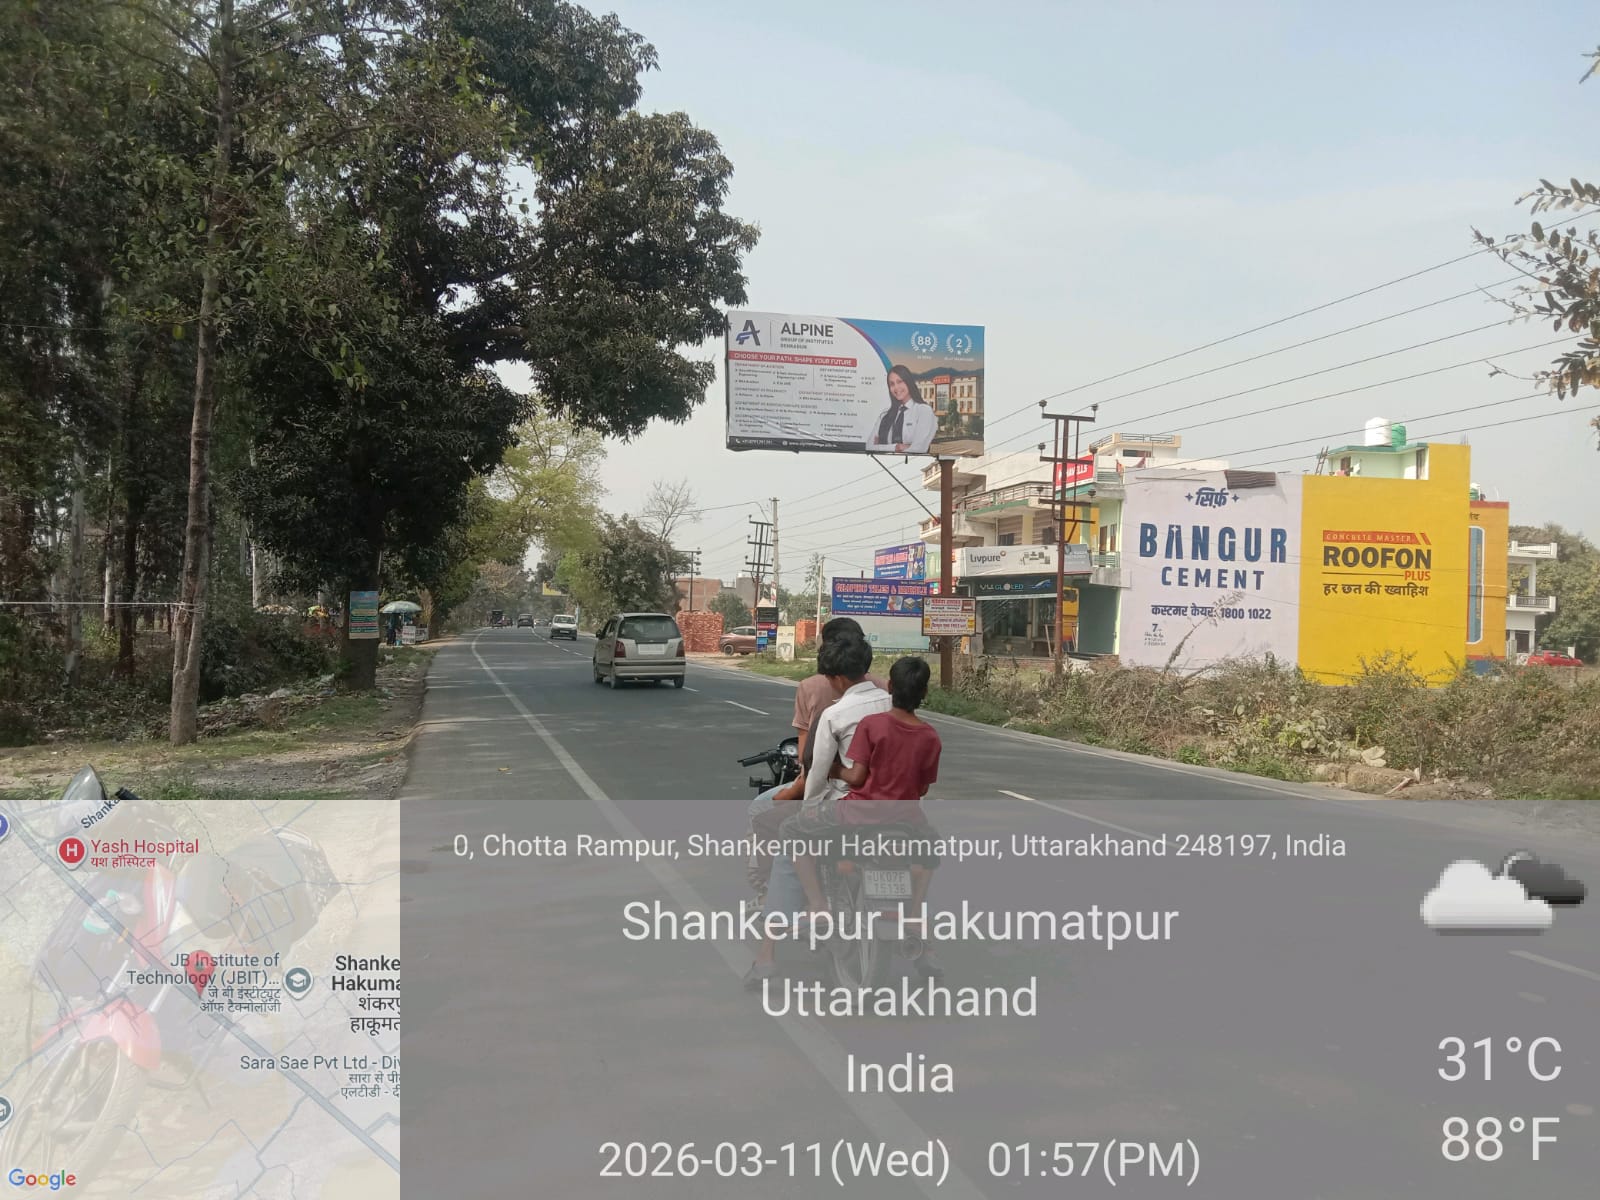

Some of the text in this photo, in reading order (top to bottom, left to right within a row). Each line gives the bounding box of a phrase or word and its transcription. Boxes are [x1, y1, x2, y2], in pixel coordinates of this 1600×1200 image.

[780, 322, 834, 338] ALPINE
[917, 336, 932, 346] 88
[955, 338, 963, 348] 2
[1139, 523, 1287, 563] BANGUR
[1326, 533, 1411, 542] CONCRETE MASTER
[1323, 545, 1432, 569] ROOFON
[1161, 566, 1265, 590] CEMENT
[1404, 570, 1431, 581] PLUS
[1323, 580, 1429, 598] हर छत की ख्वाहिश
[1151, 604, 1188, 616] कस्टमर
[1220, 607, 1245, 619] 1800
[1248, 608, 1272, 619] 1022
